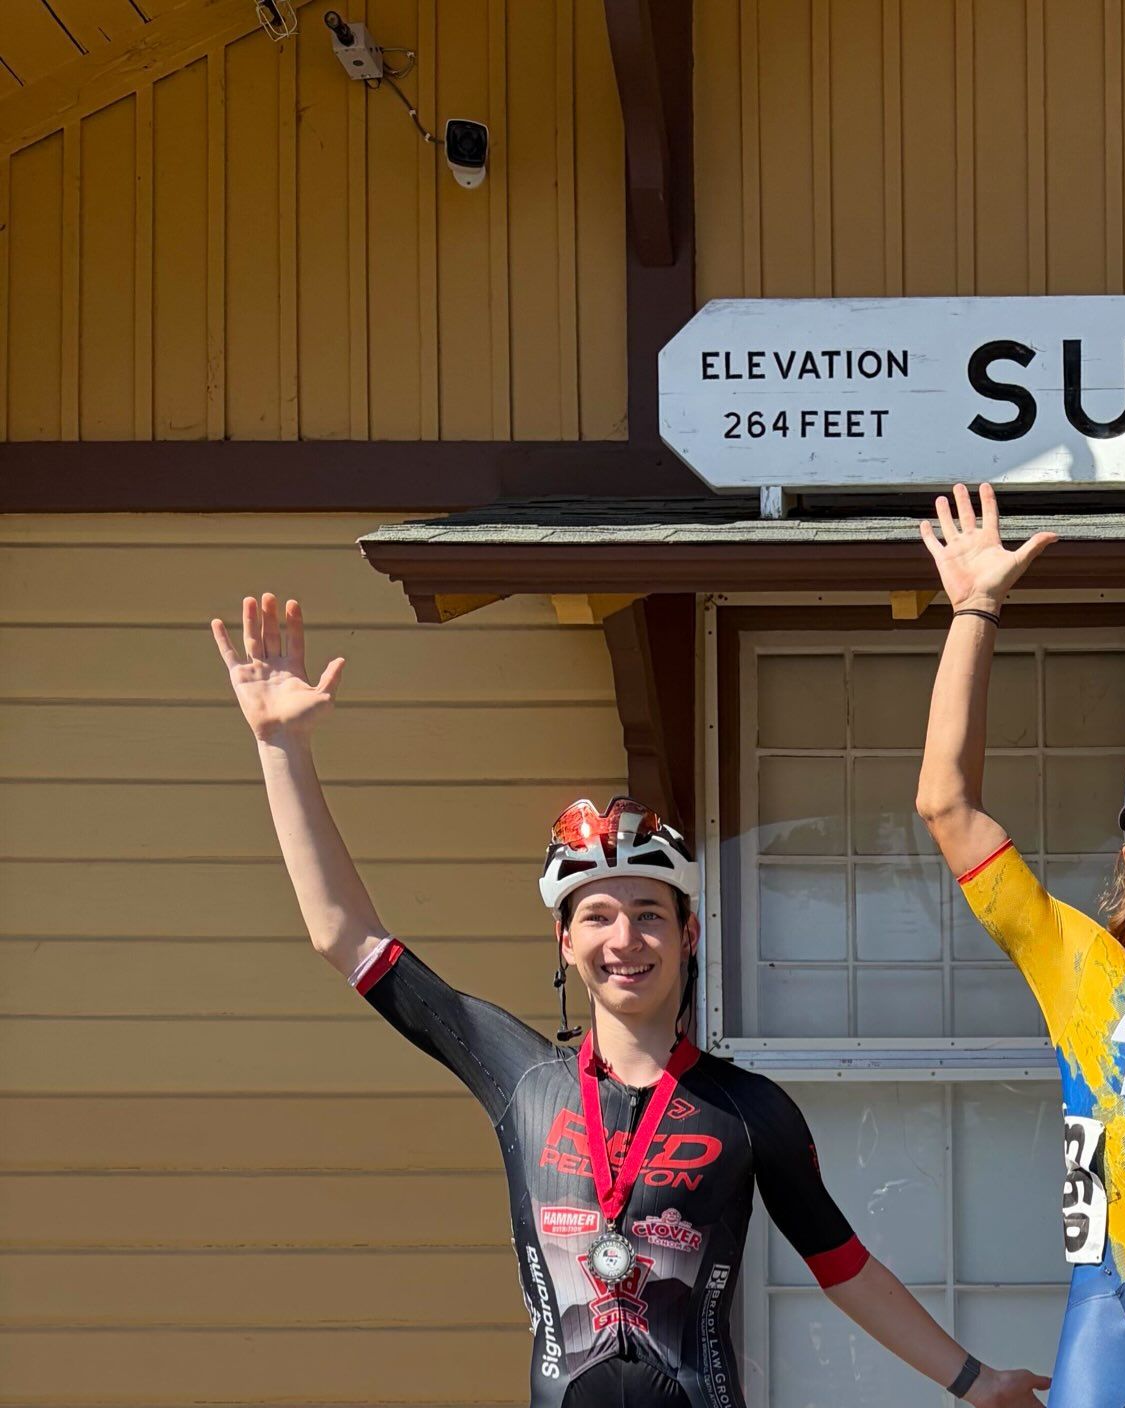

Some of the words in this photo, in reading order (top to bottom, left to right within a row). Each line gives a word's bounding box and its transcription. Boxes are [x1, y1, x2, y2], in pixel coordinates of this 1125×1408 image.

[702, 350, 909, 380] ELEVATION
[723, 411, 789, 439] 264
[801, 410, 889, 438] FEET
[539, 1146, 704, 1191] PELON
[543, 1211, 596, 1226] HAMMER
[633, 1223, 701, 1249] CLOVER
[528, 1245, 563, 1380] Signarama
[707, 1290, 721, 1334] BRADY
[709, 1339, 722, 1369] LAW
